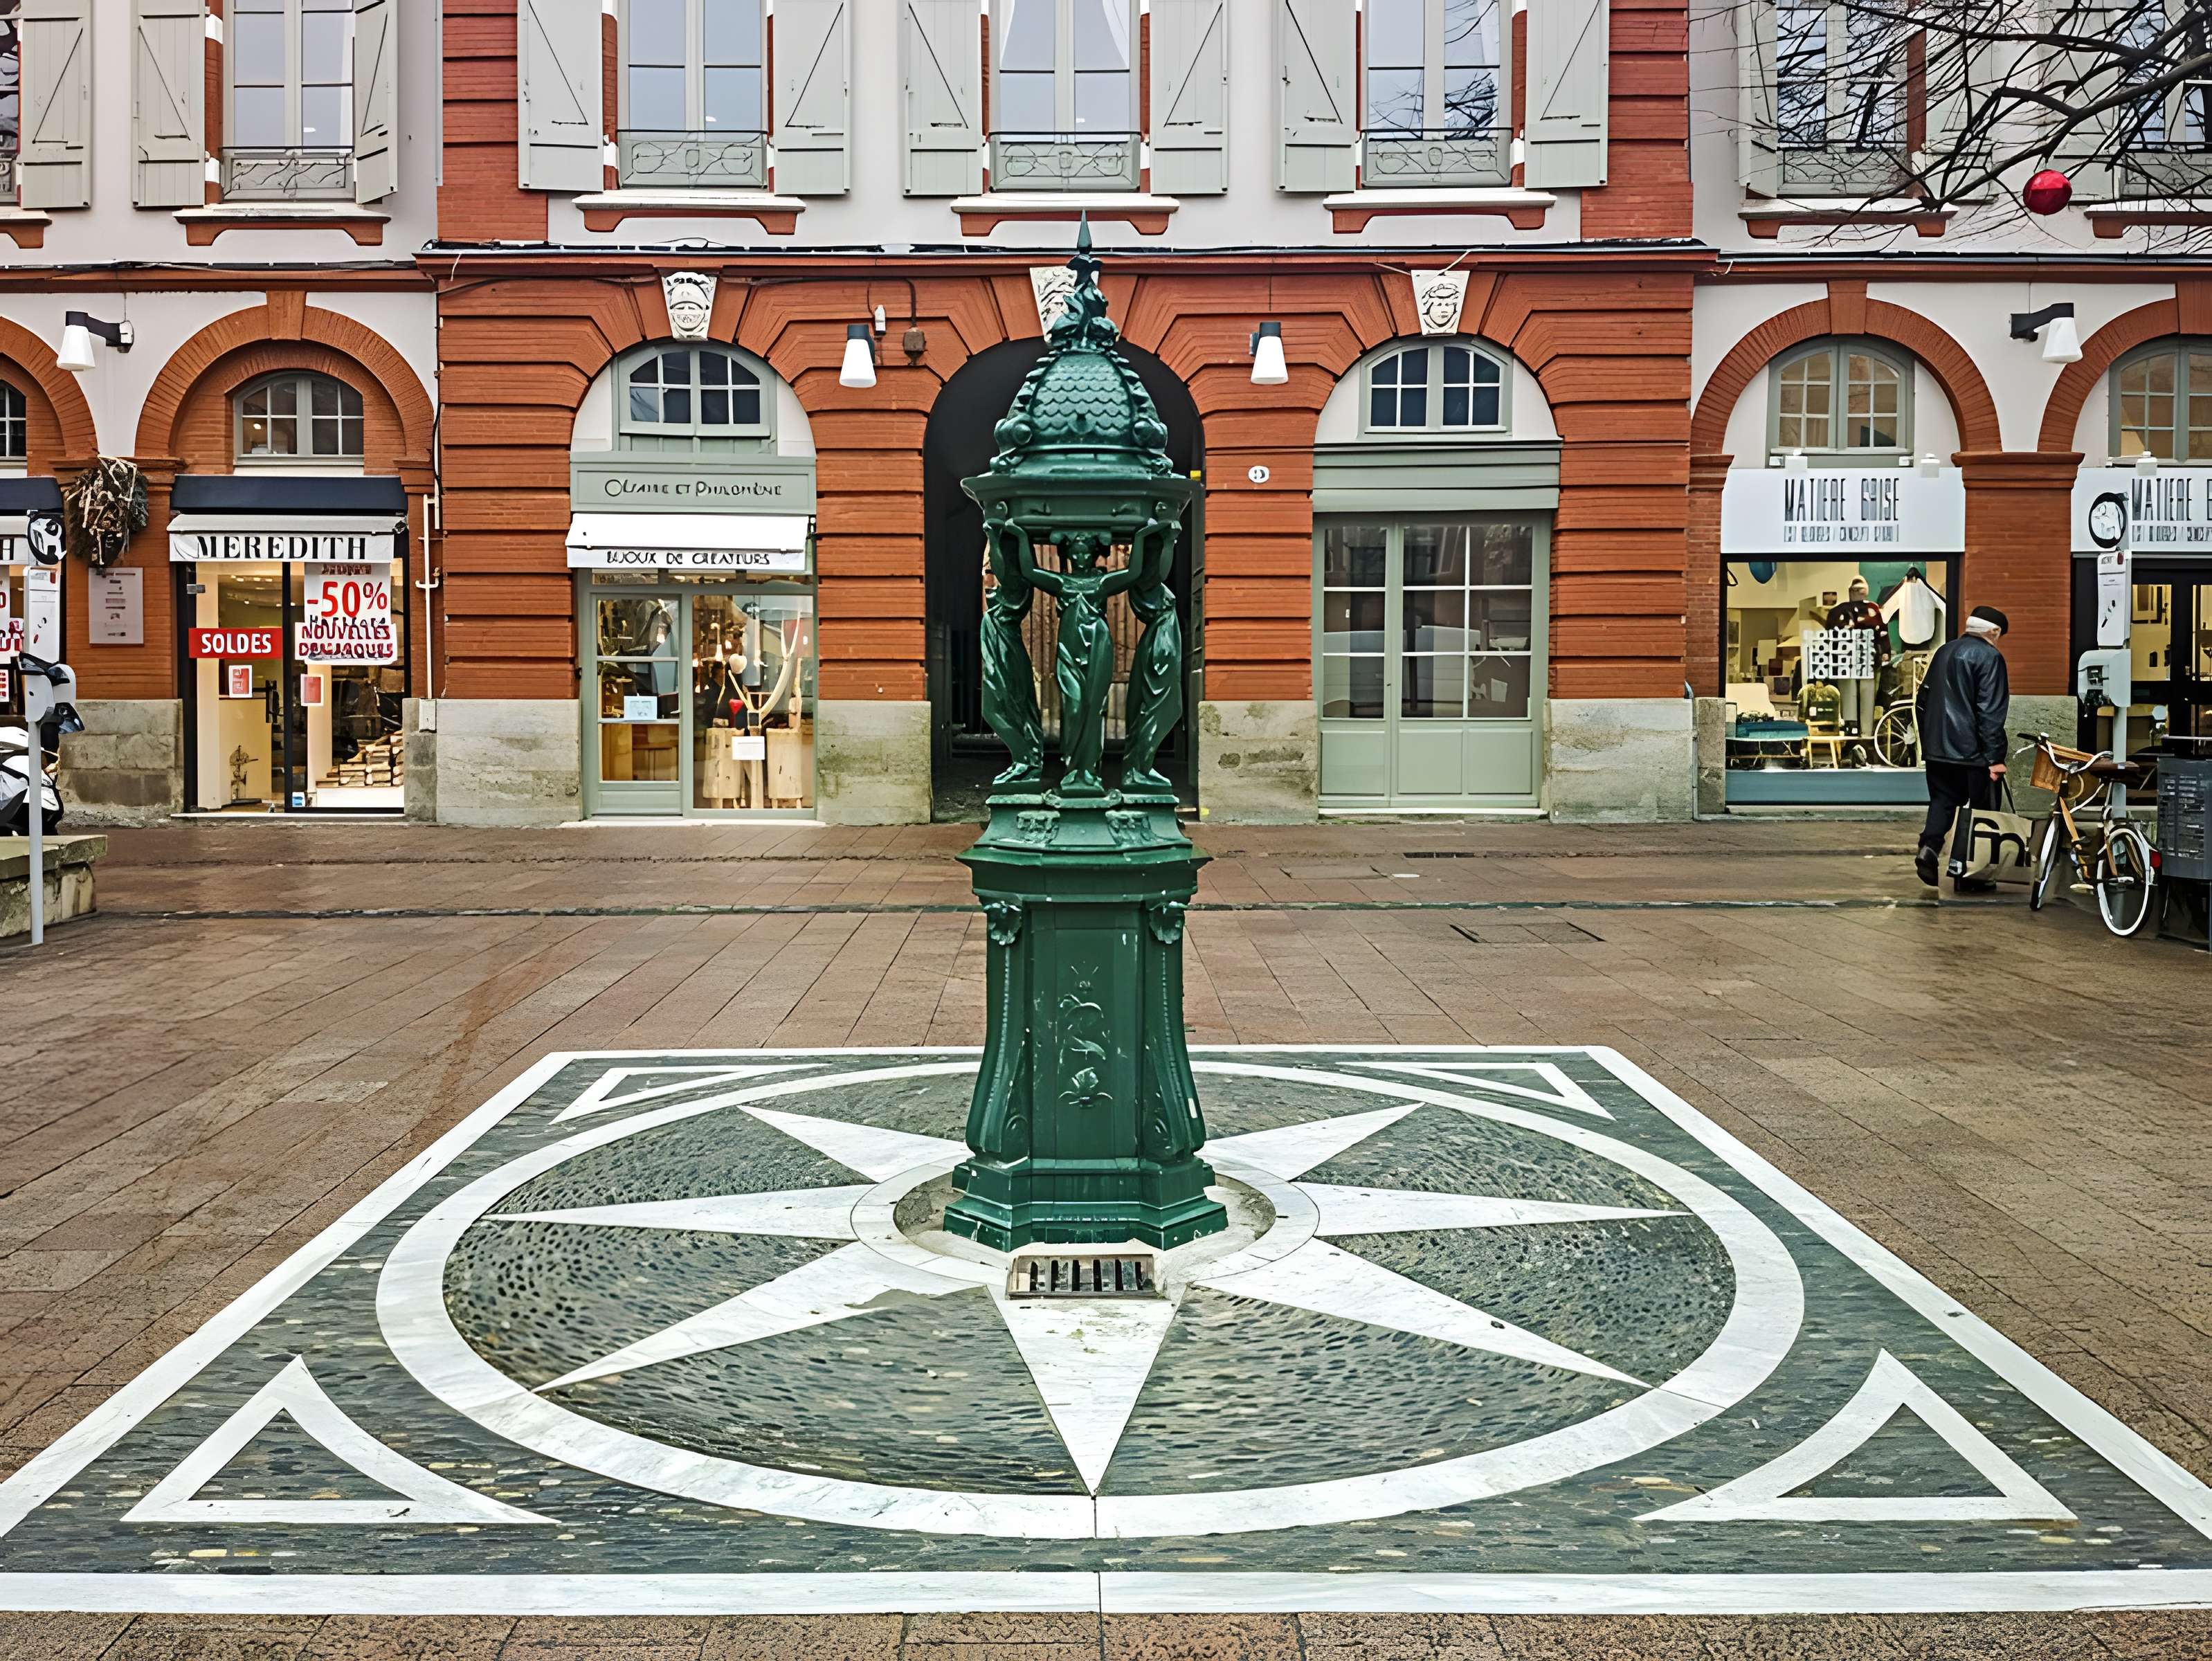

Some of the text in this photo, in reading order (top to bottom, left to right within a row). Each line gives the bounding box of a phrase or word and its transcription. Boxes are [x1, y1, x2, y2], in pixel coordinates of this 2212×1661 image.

[197, 536, 366, 560] MEREDITH
[307, 581, 388, 618] -50%
[201, 633, 272, 654] SOLDES
